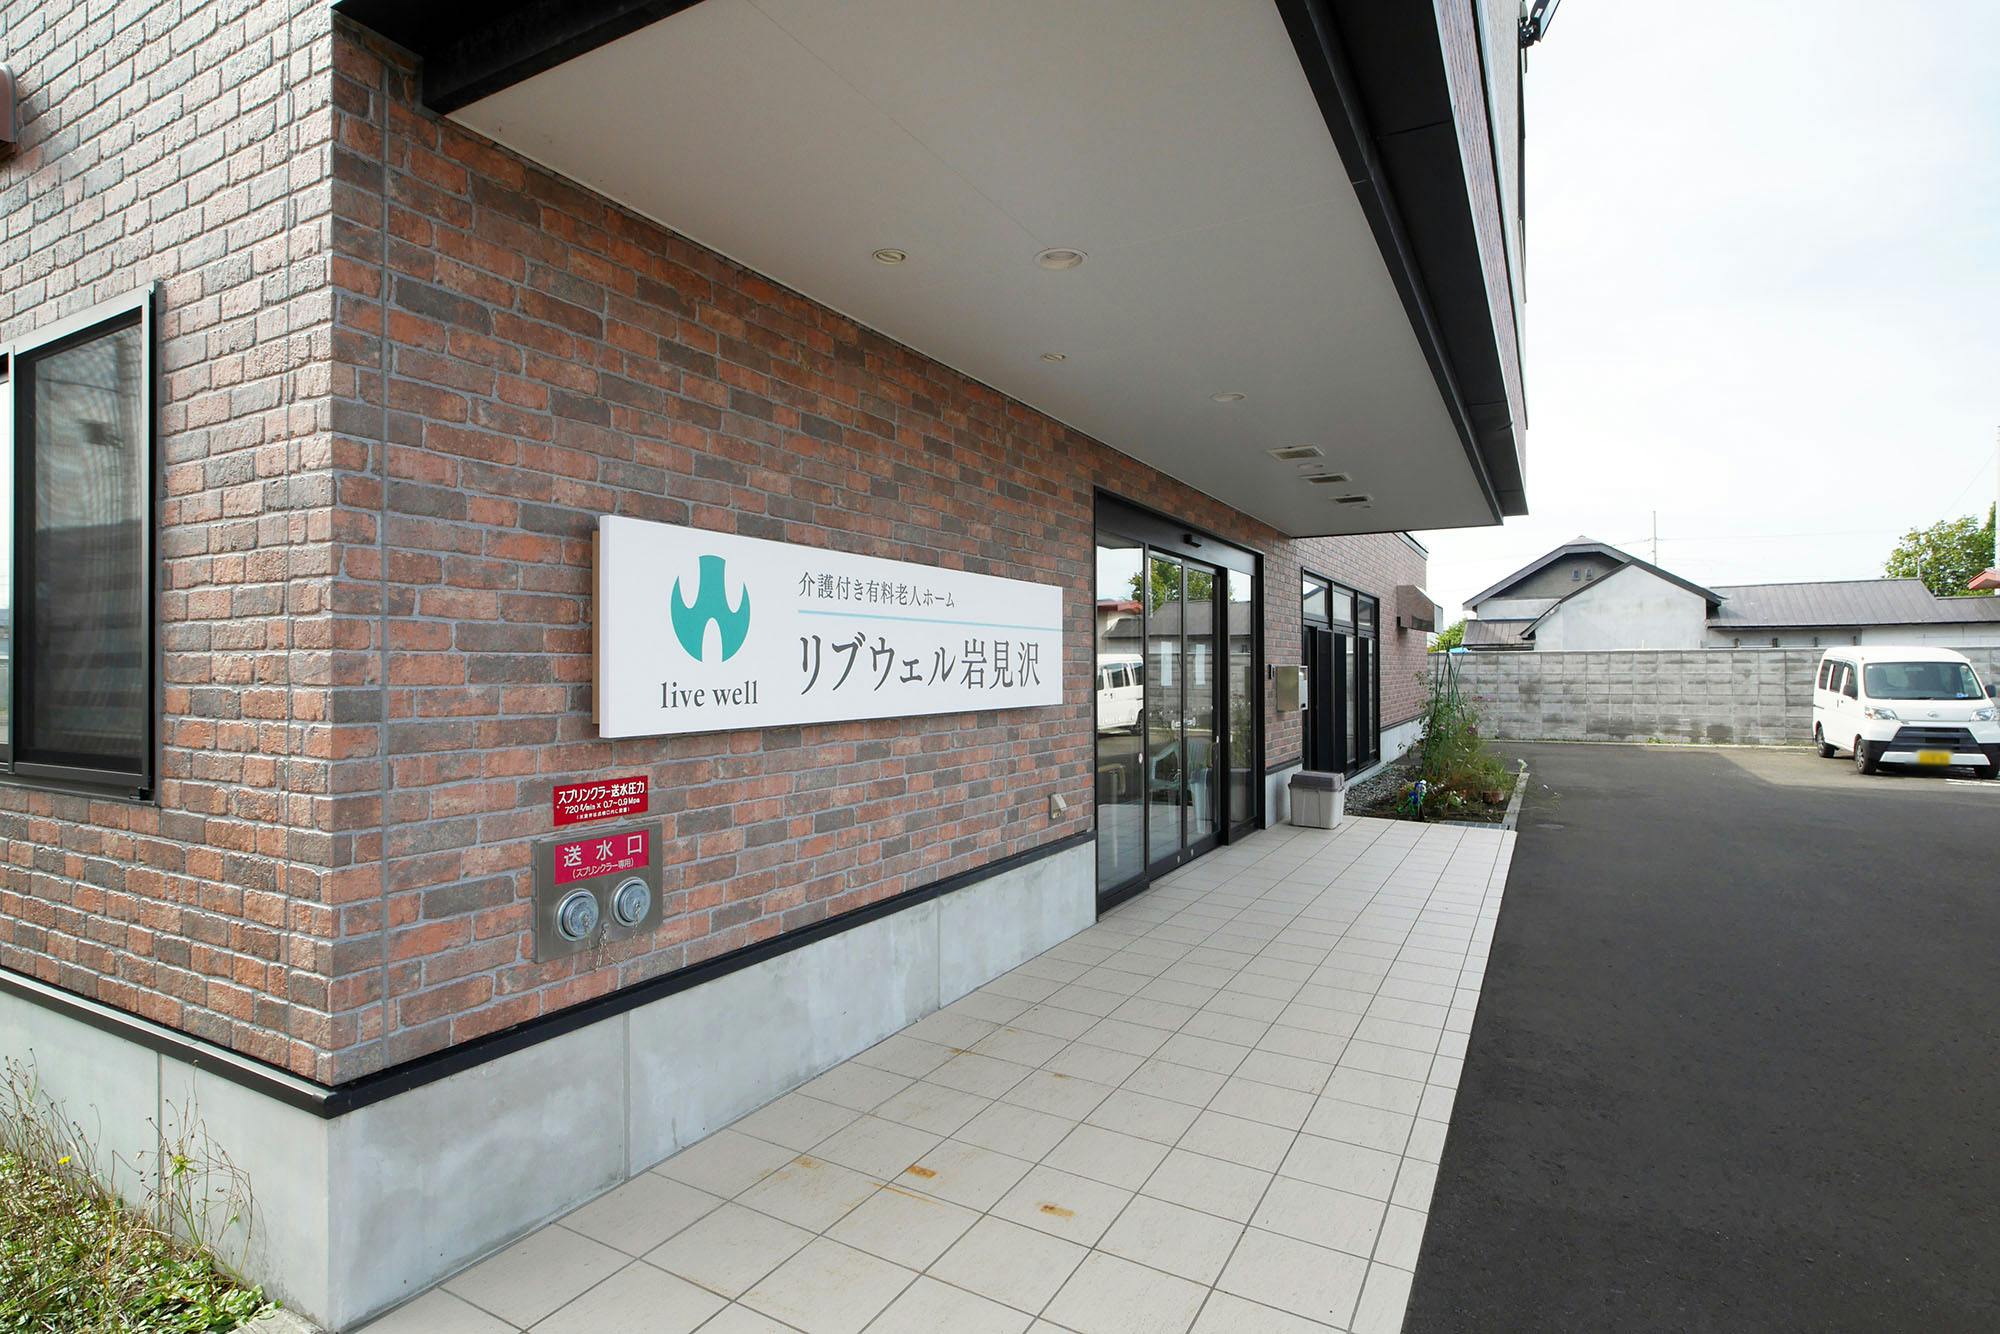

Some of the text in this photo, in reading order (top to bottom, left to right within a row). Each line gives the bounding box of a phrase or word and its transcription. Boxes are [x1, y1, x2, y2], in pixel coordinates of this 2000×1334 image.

[798, 571, 955, 608] 介護付き有料老人ホーム
[799, 631, 1041, 695] リブウェル岩見沢
[660, 680, 758, 708] live well
[558, 780, 645, 804] スプリンクラー送水圧力
